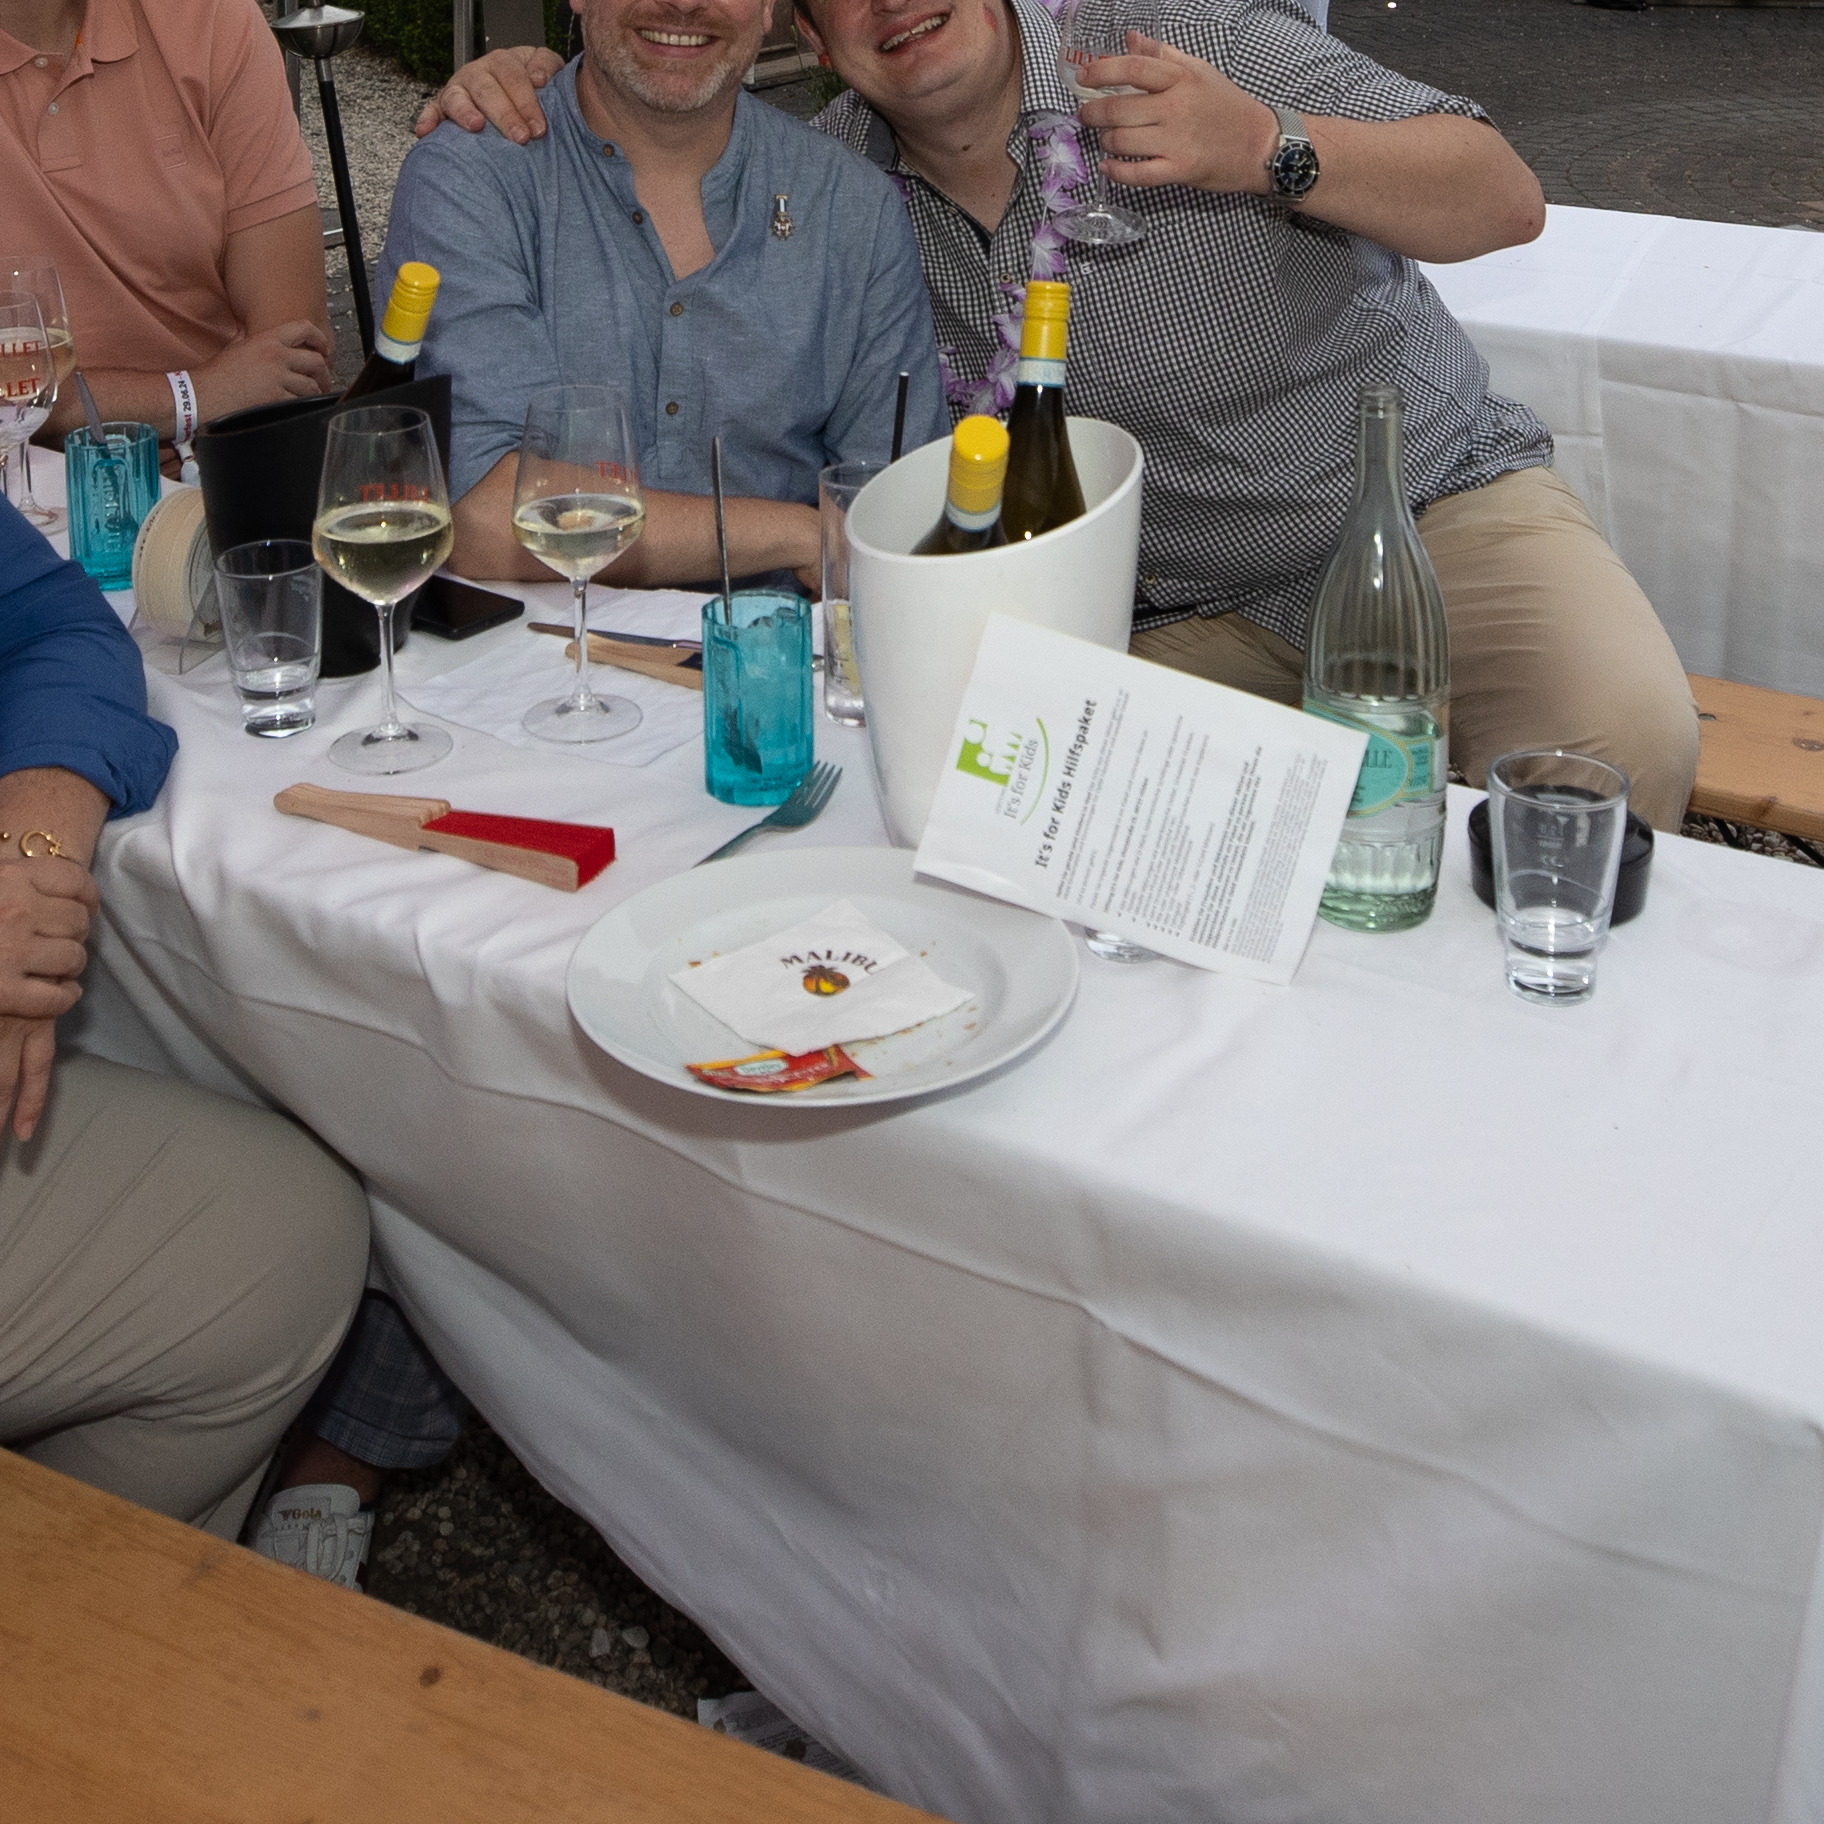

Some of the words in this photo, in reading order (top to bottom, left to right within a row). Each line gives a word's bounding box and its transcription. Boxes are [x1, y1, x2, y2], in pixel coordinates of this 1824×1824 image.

[1062, 698, 1098, 779] Hilfspaket
[1017, 737, 1039, 772] Kids
[1010, 773, 1028, 797] for
[1051, 780, 1072, 815] Kids
[1042, 816, 1062, 841] for
[292, 1508, 322, 1520] Gola
